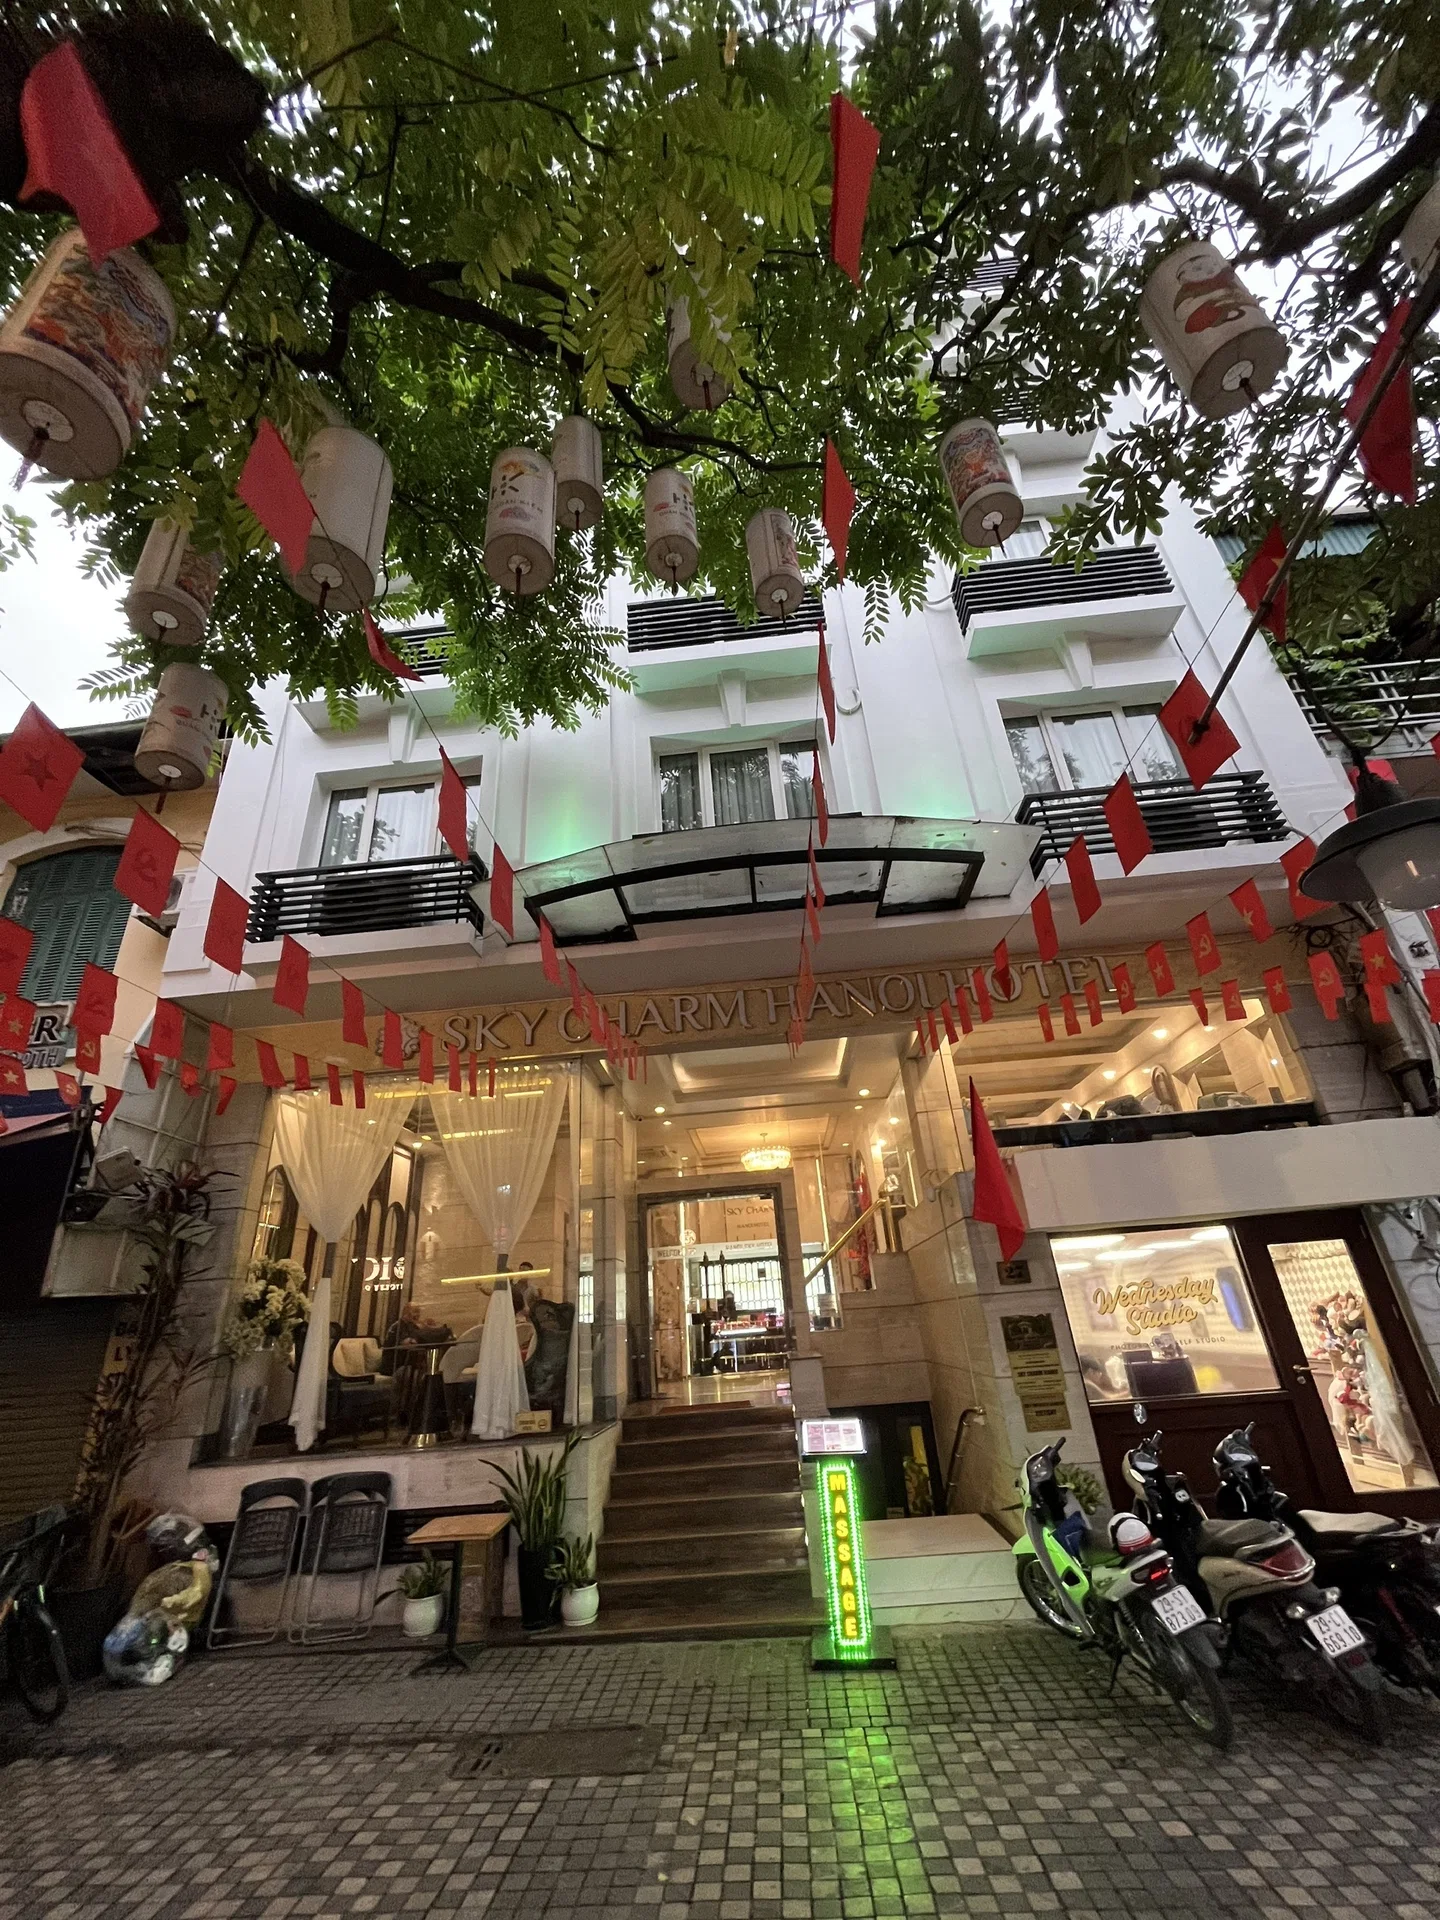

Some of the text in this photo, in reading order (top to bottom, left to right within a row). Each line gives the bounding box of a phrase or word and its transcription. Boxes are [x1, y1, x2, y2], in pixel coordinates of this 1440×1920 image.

[441, 955, 1118, 1052] SKY CHARM HANOI HOTEL
[1092, 1276, 1219, 1316] Wednesday
[1125, 1303, 1199, 1336] Studio
[1195, 1336, 1226, 1345] STUDIO
[828, 1473, 858, 1638] MASSAGE
